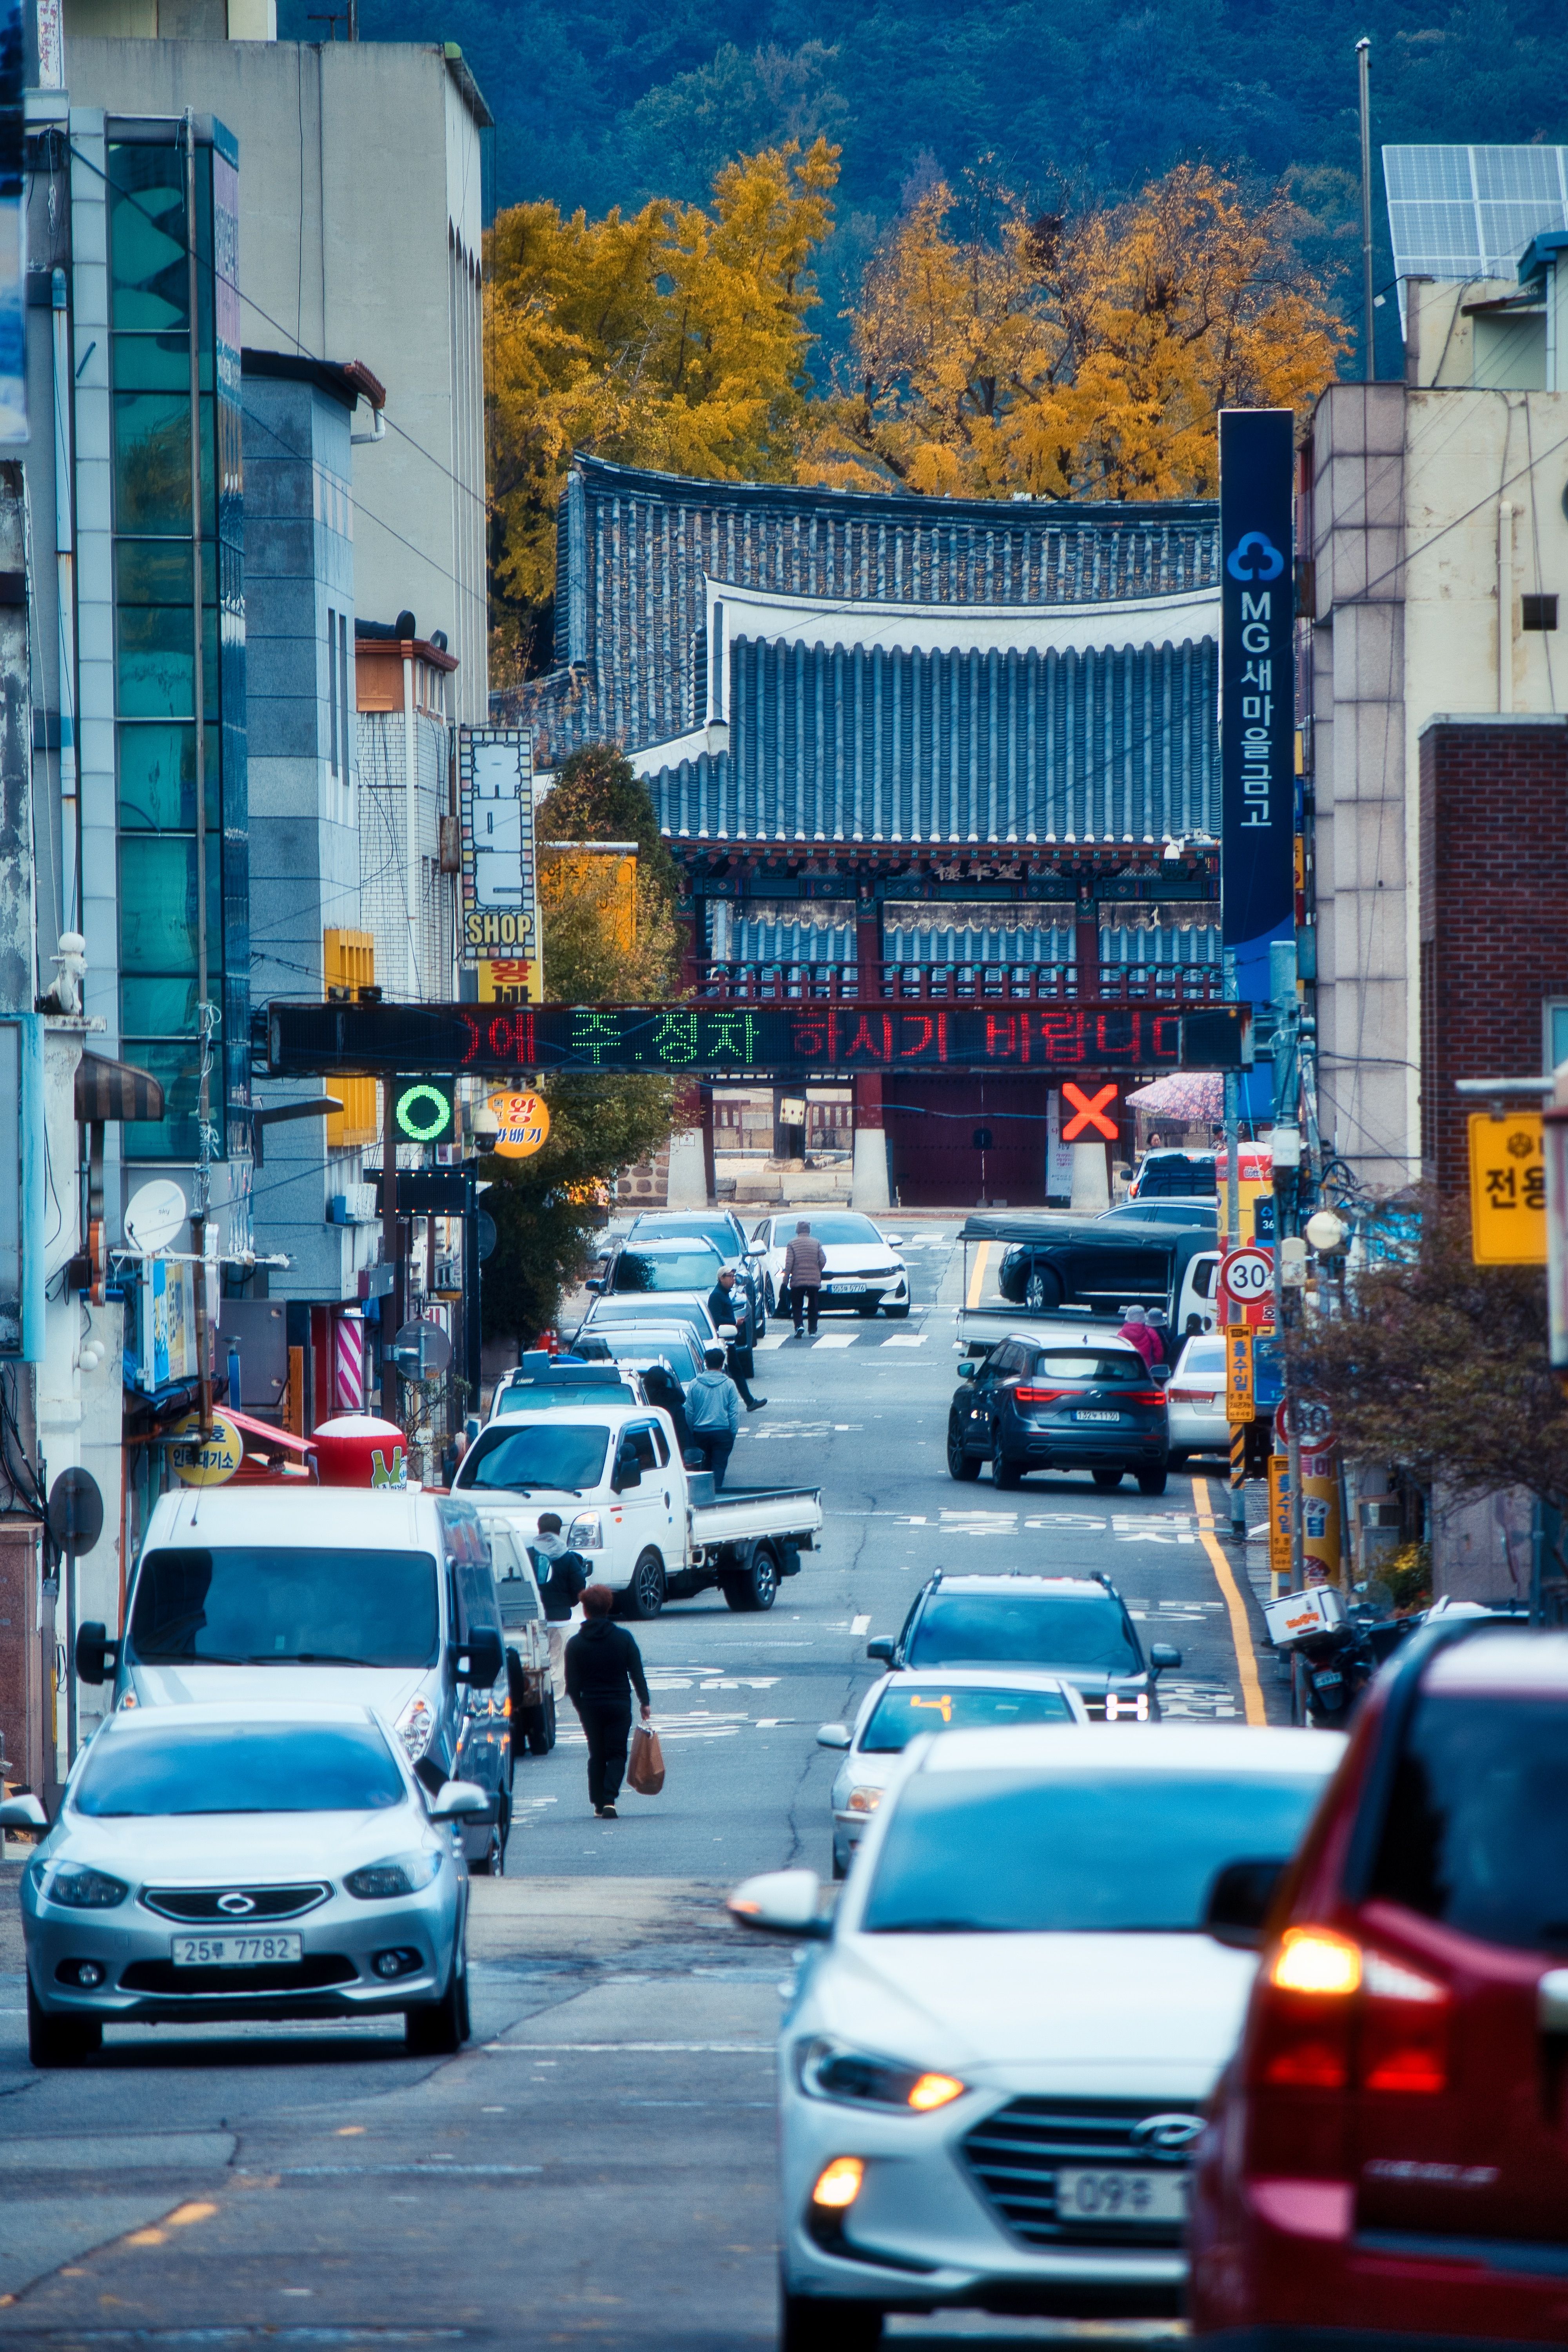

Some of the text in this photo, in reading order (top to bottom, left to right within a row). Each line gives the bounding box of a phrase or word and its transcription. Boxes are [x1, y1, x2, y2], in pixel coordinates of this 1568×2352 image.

[1241, 592, 1274, 826] MG새마을금고
[468, 914, 532, 945] SHOP
[790, 1011, 947, 1063] 하시기
[507, 1097, 537, 1124] 왕
[1262, 1220, 1275, 1229] 36
[1233, 1264, 1266, 1289] 30
[235, 1938, 287, 1960] 7782
